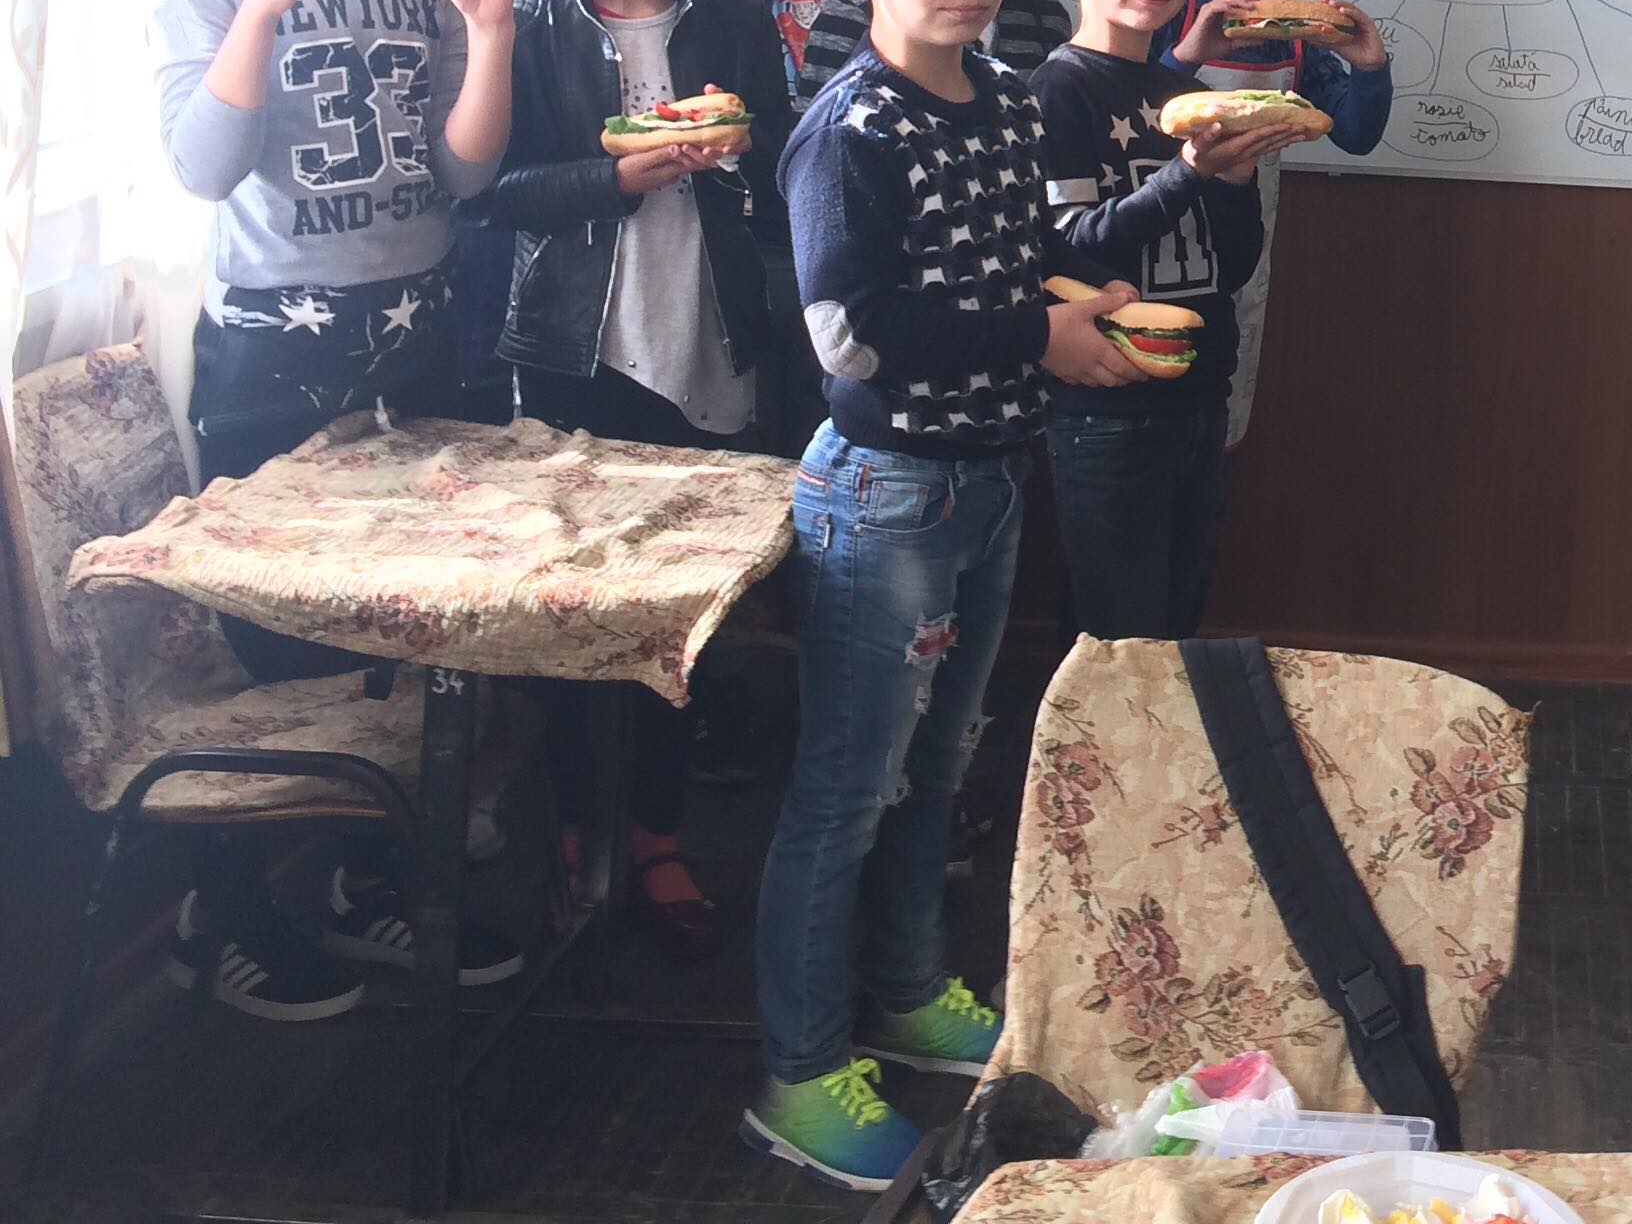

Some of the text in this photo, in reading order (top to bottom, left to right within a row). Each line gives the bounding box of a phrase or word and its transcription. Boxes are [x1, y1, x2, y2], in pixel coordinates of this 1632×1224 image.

[278, 36, 435, 192] 33
[1410, 118, 1491, 145] tomato
[1574, 119, 1629, 156] bread
[431, 667, 465, 695] 34
